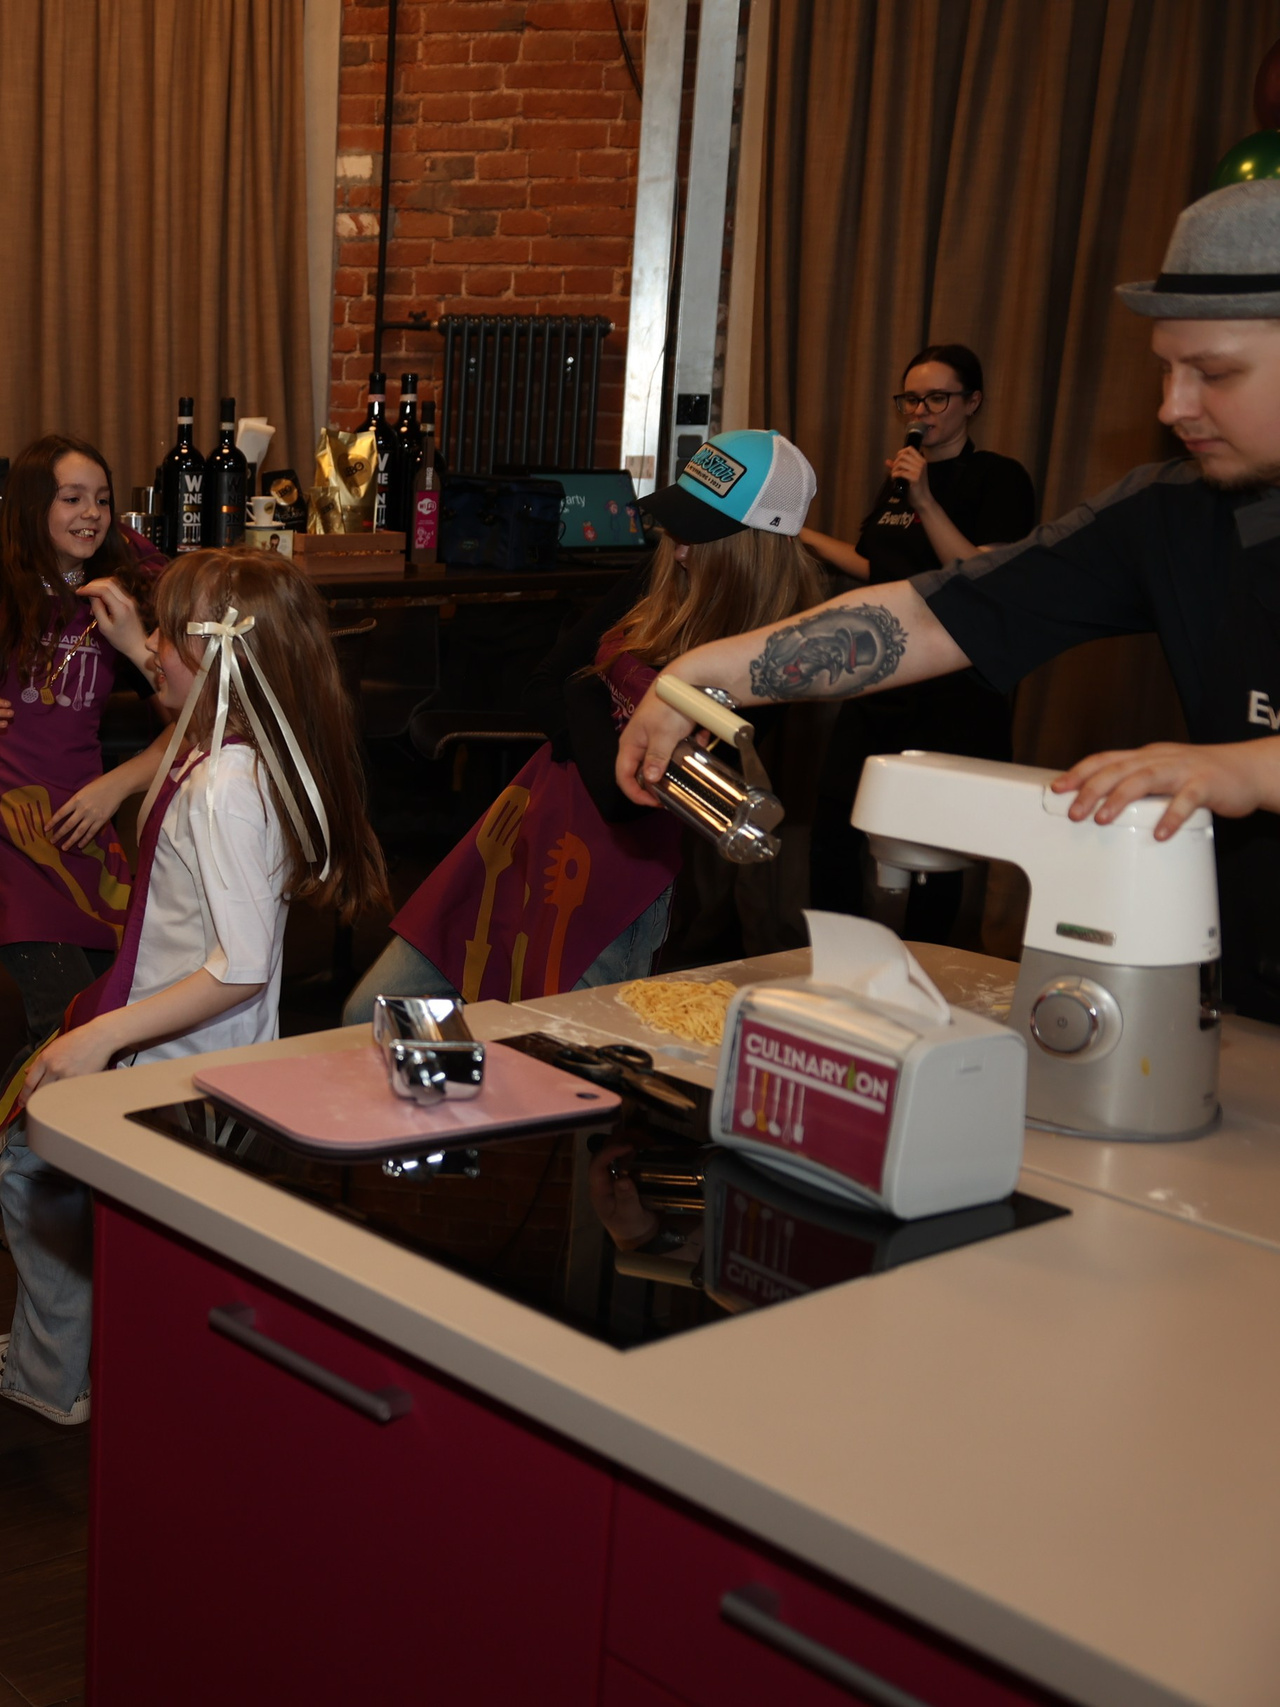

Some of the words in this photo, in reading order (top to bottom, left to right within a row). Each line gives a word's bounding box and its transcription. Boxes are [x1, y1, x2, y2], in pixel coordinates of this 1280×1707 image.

[184, 474, 203, 492] W
[183, 512, 200, 523] ON
[745, 1032, 848, 1086] CULINARY
[855, 1071, 890, 1101] ON
